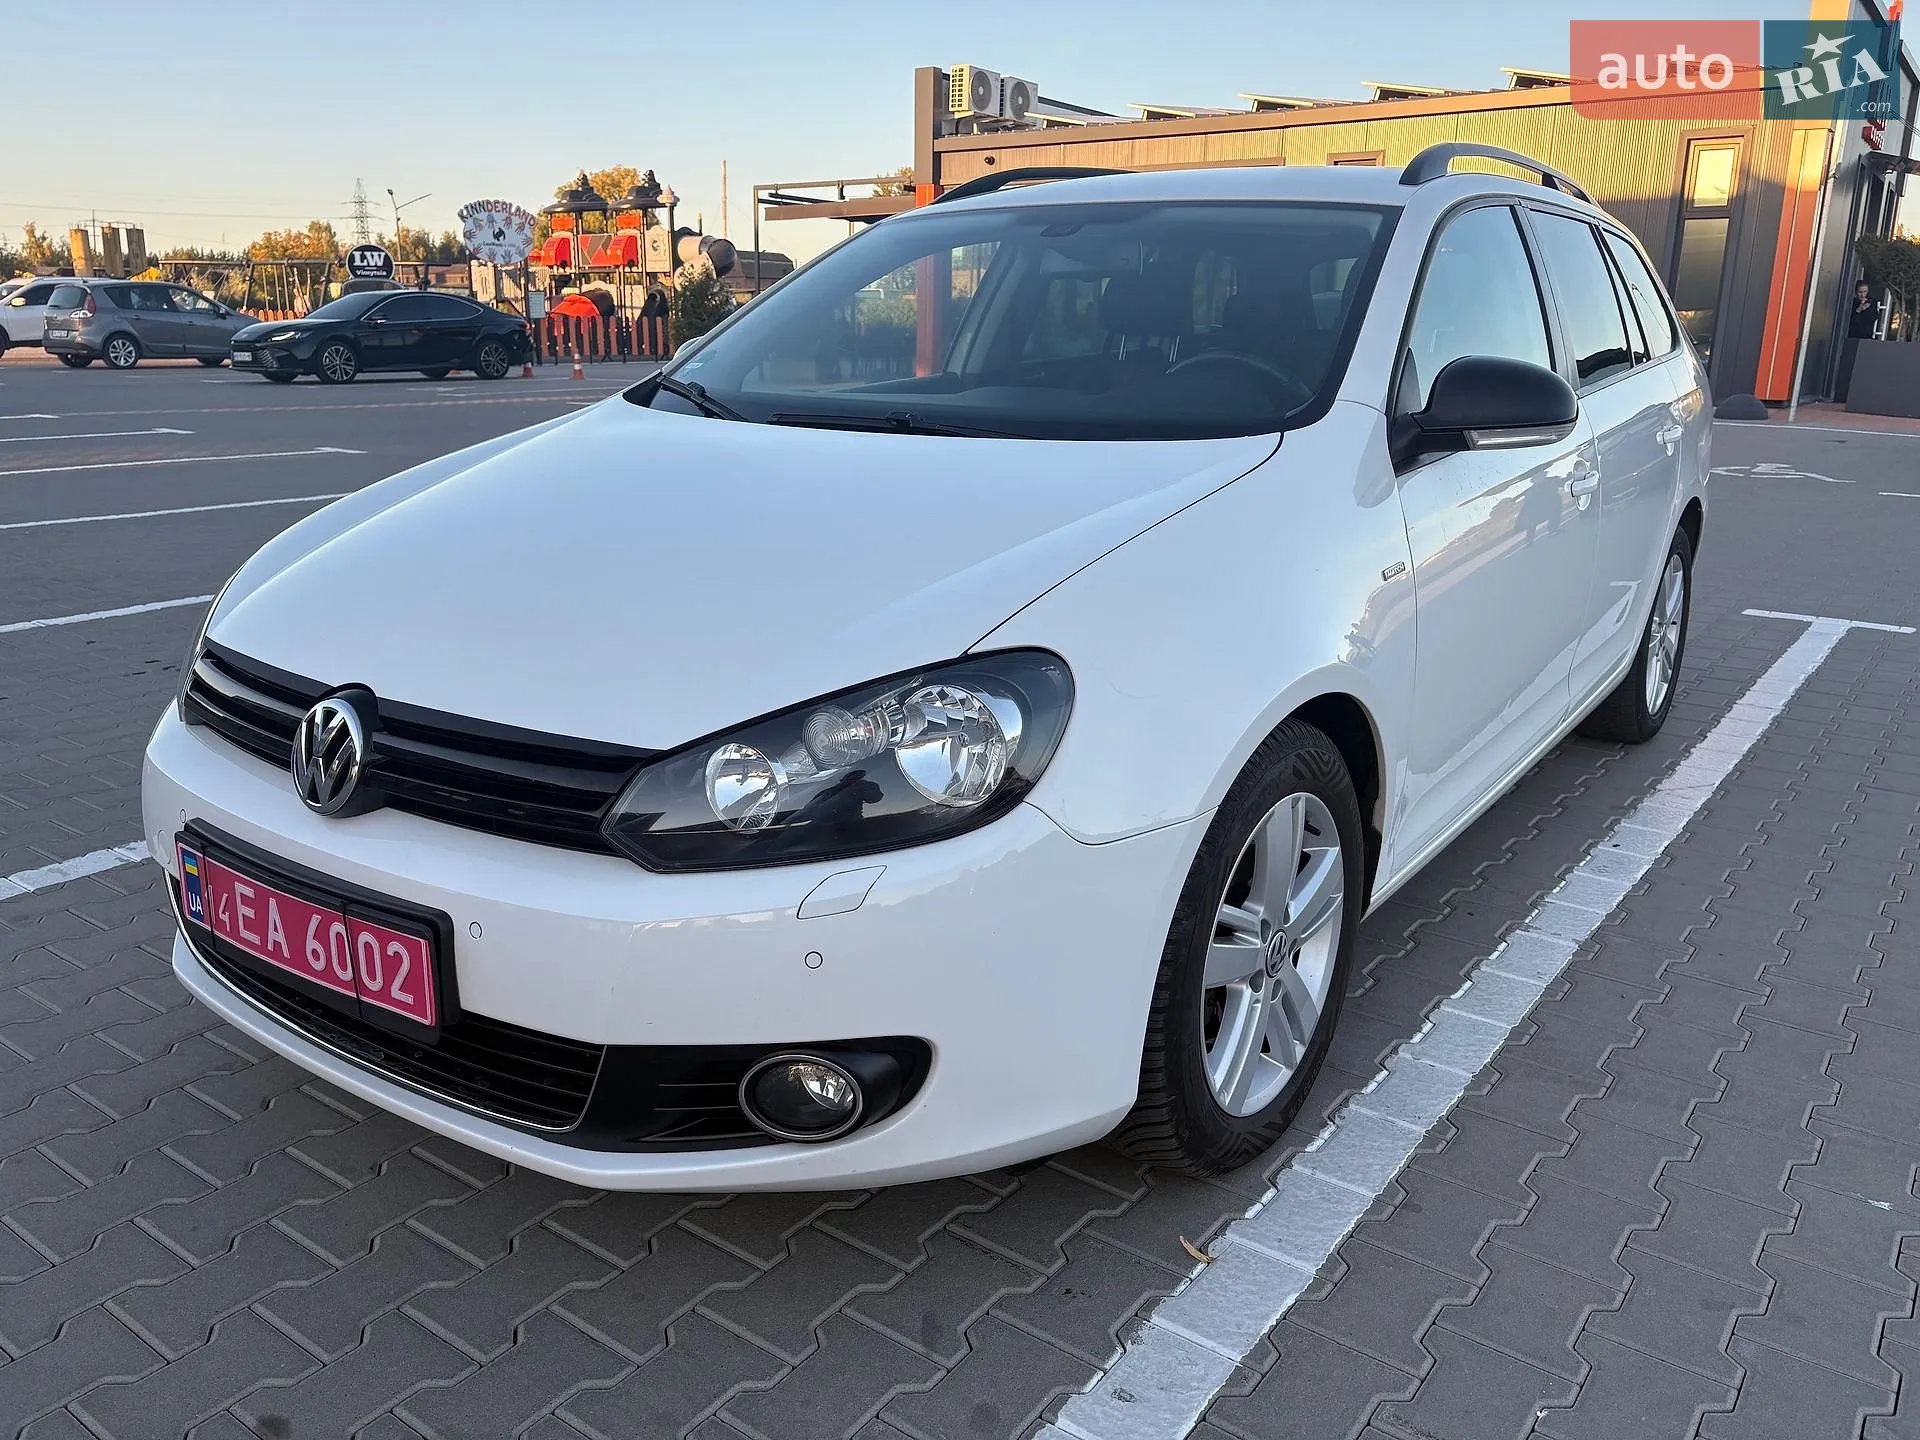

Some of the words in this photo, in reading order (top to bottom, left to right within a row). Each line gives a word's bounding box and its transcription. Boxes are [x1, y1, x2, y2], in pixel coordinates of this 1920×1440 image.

[457, 199, 537, 227] KINNDERLAND
[352, 251, 386, 266] LW
[188, 891, 204, 916] UA
[305, 914, 415, 1006] 6002
